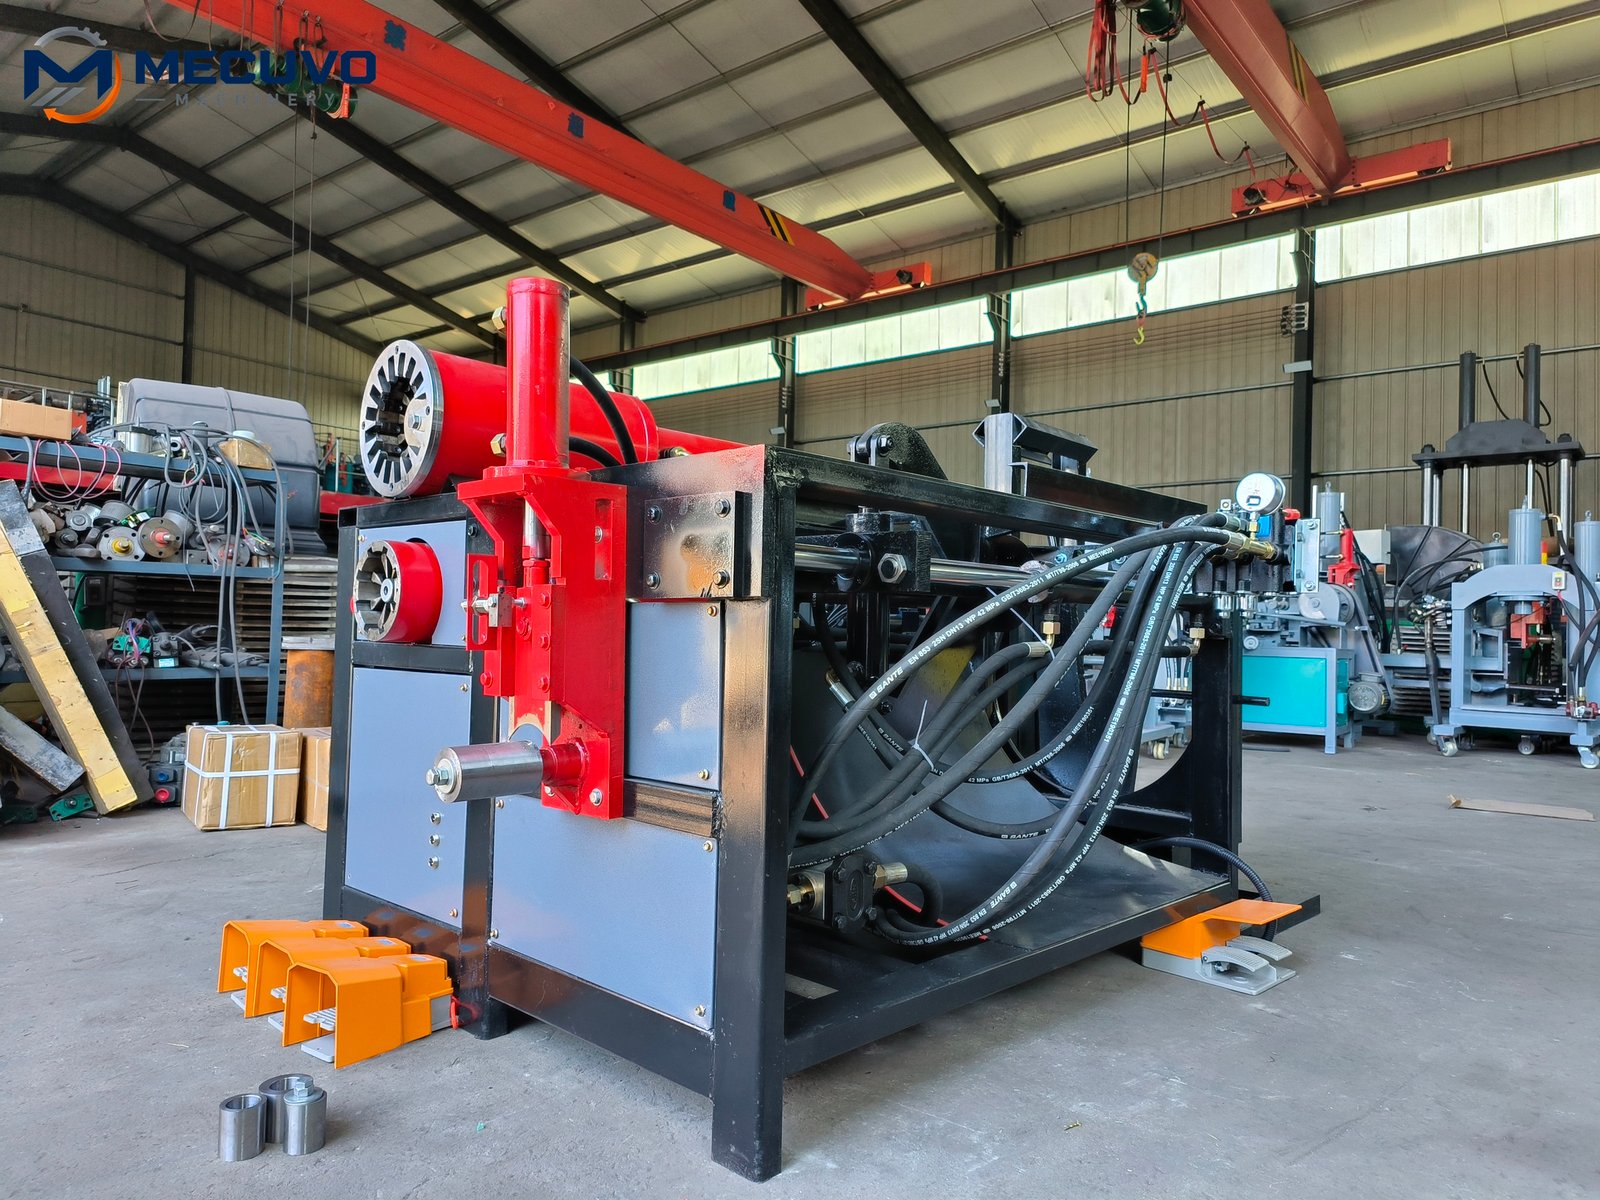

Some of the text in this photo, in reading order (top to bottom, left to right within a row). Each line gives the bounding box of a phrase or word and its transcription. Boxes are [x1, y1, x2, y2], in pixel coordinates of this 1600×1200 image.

[876, 666, 904, 693] SANTE
[907, 655, 919, 665] EN
[931, 635, 948, 647] 2SN
[945, 622, 965, 637] DN13
[964, 614, 977, 625] WP
[977, 609, 986, 618] 42
[985, 601, 1000, 612] MPa
[1111, 789, 1120, 800] EN
[1089, 825, 1102, 843] DN13
[1081, 843, 1091, 855] WP
[1074, 854, 1083, 862] 42
[1064, 861, 1077, 874] MPa
[990, 886, 1011, 909] SANTE
